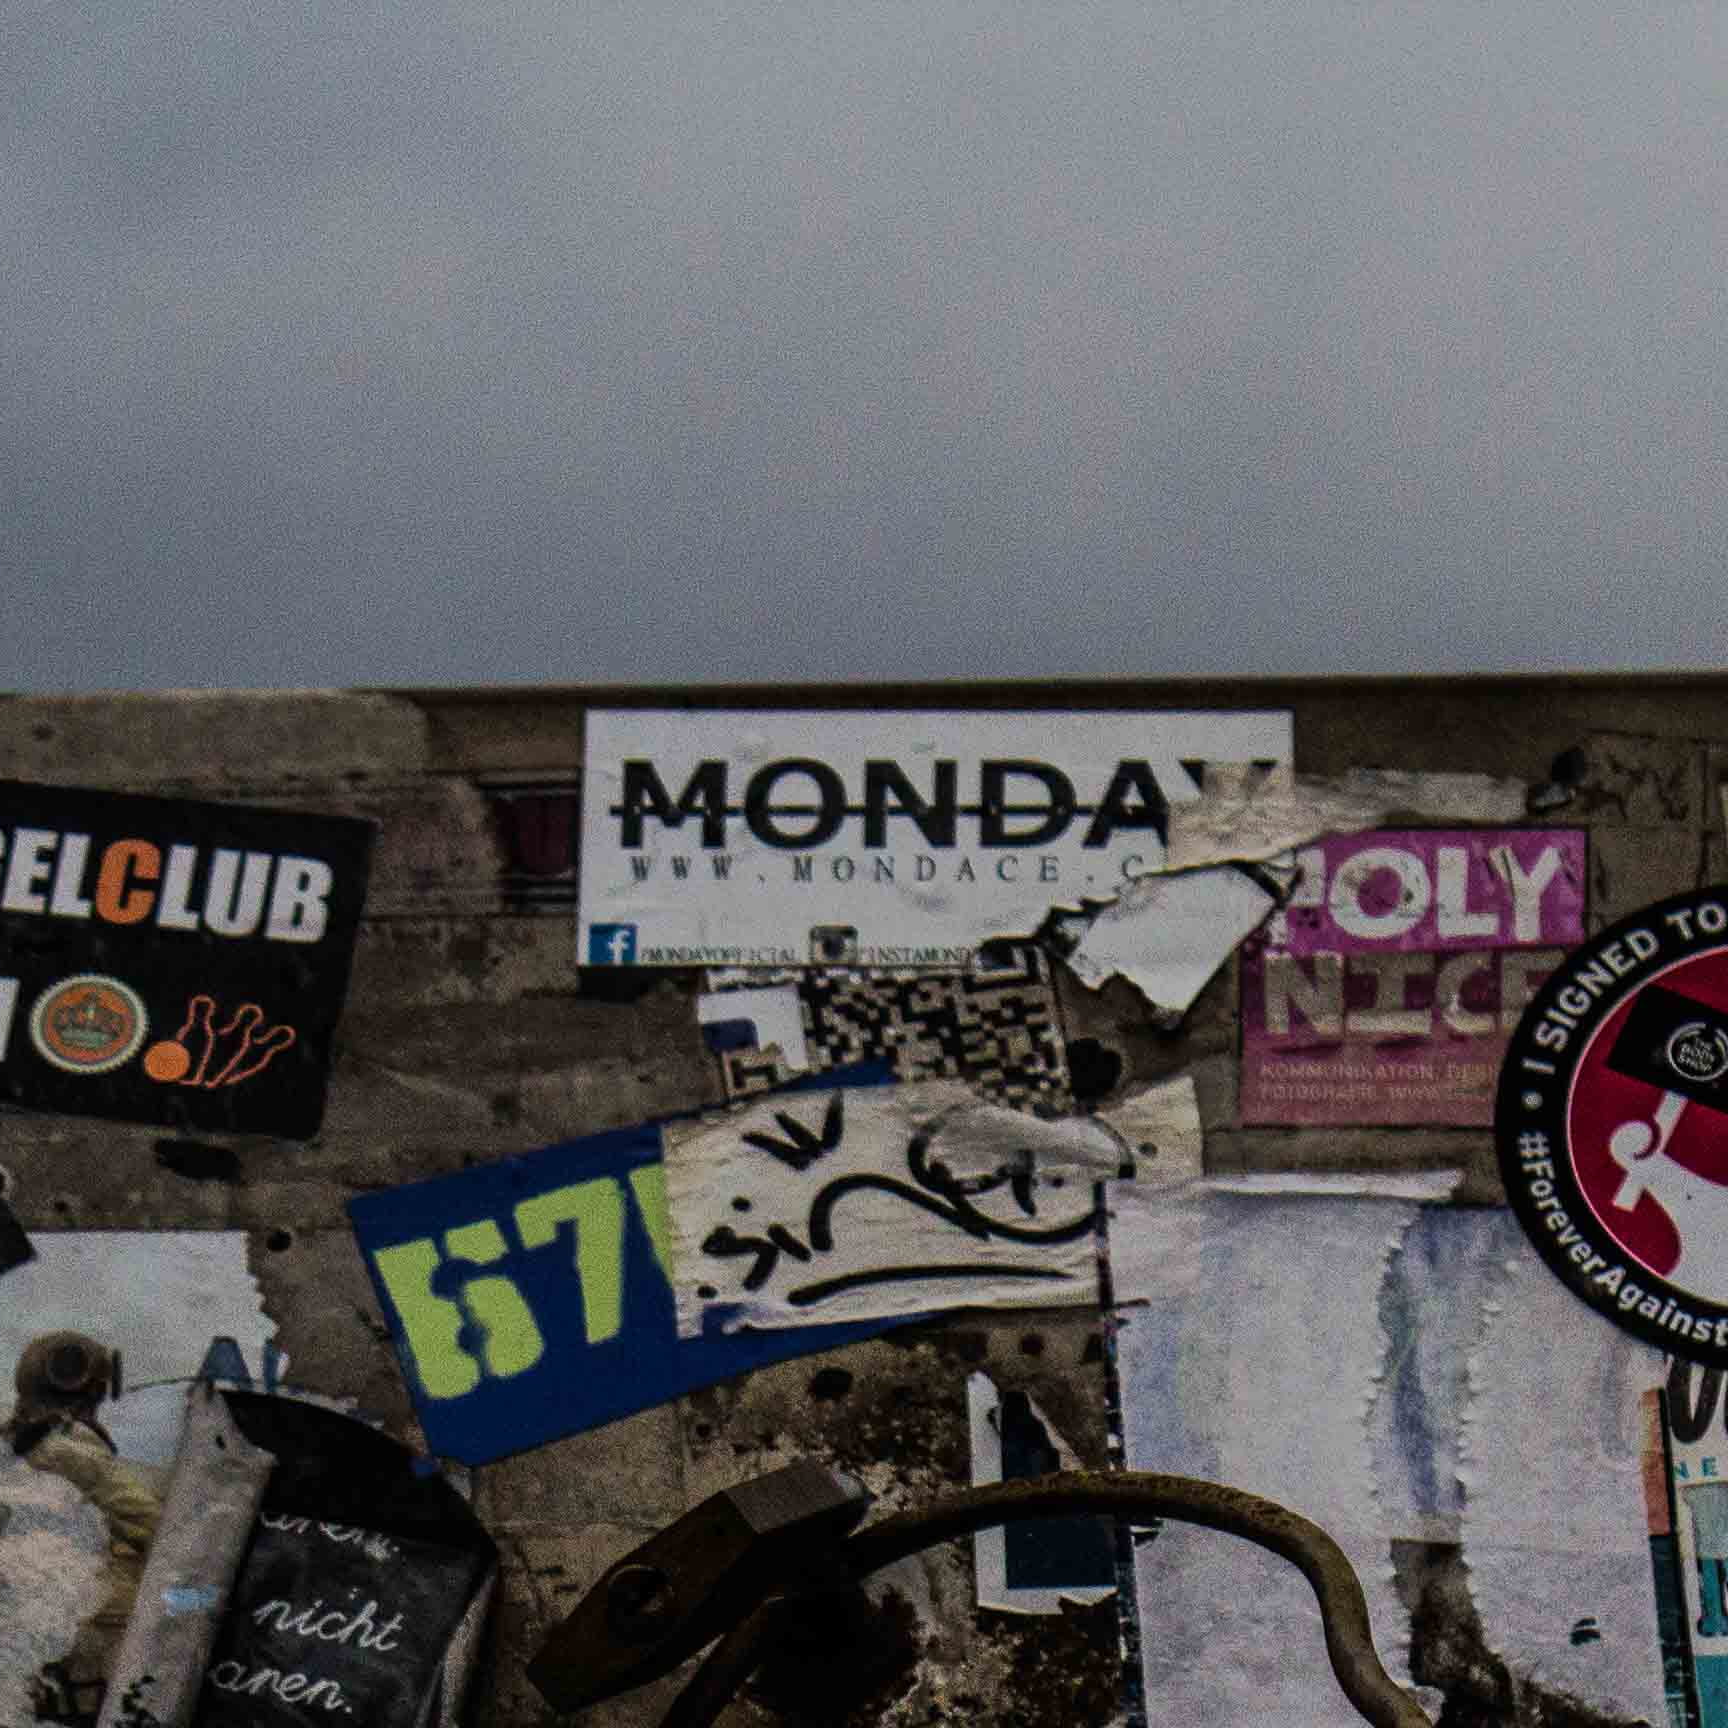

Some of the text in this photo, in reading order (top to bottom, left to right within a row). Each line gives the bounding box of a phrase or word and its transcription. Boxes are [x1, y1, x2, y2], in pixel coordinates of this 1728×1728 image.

[1533, 928, 1661, 1053] SIGNED
[1664, 900, 1728, 942] TO
[250, 1587, 405, 1653] nicht
